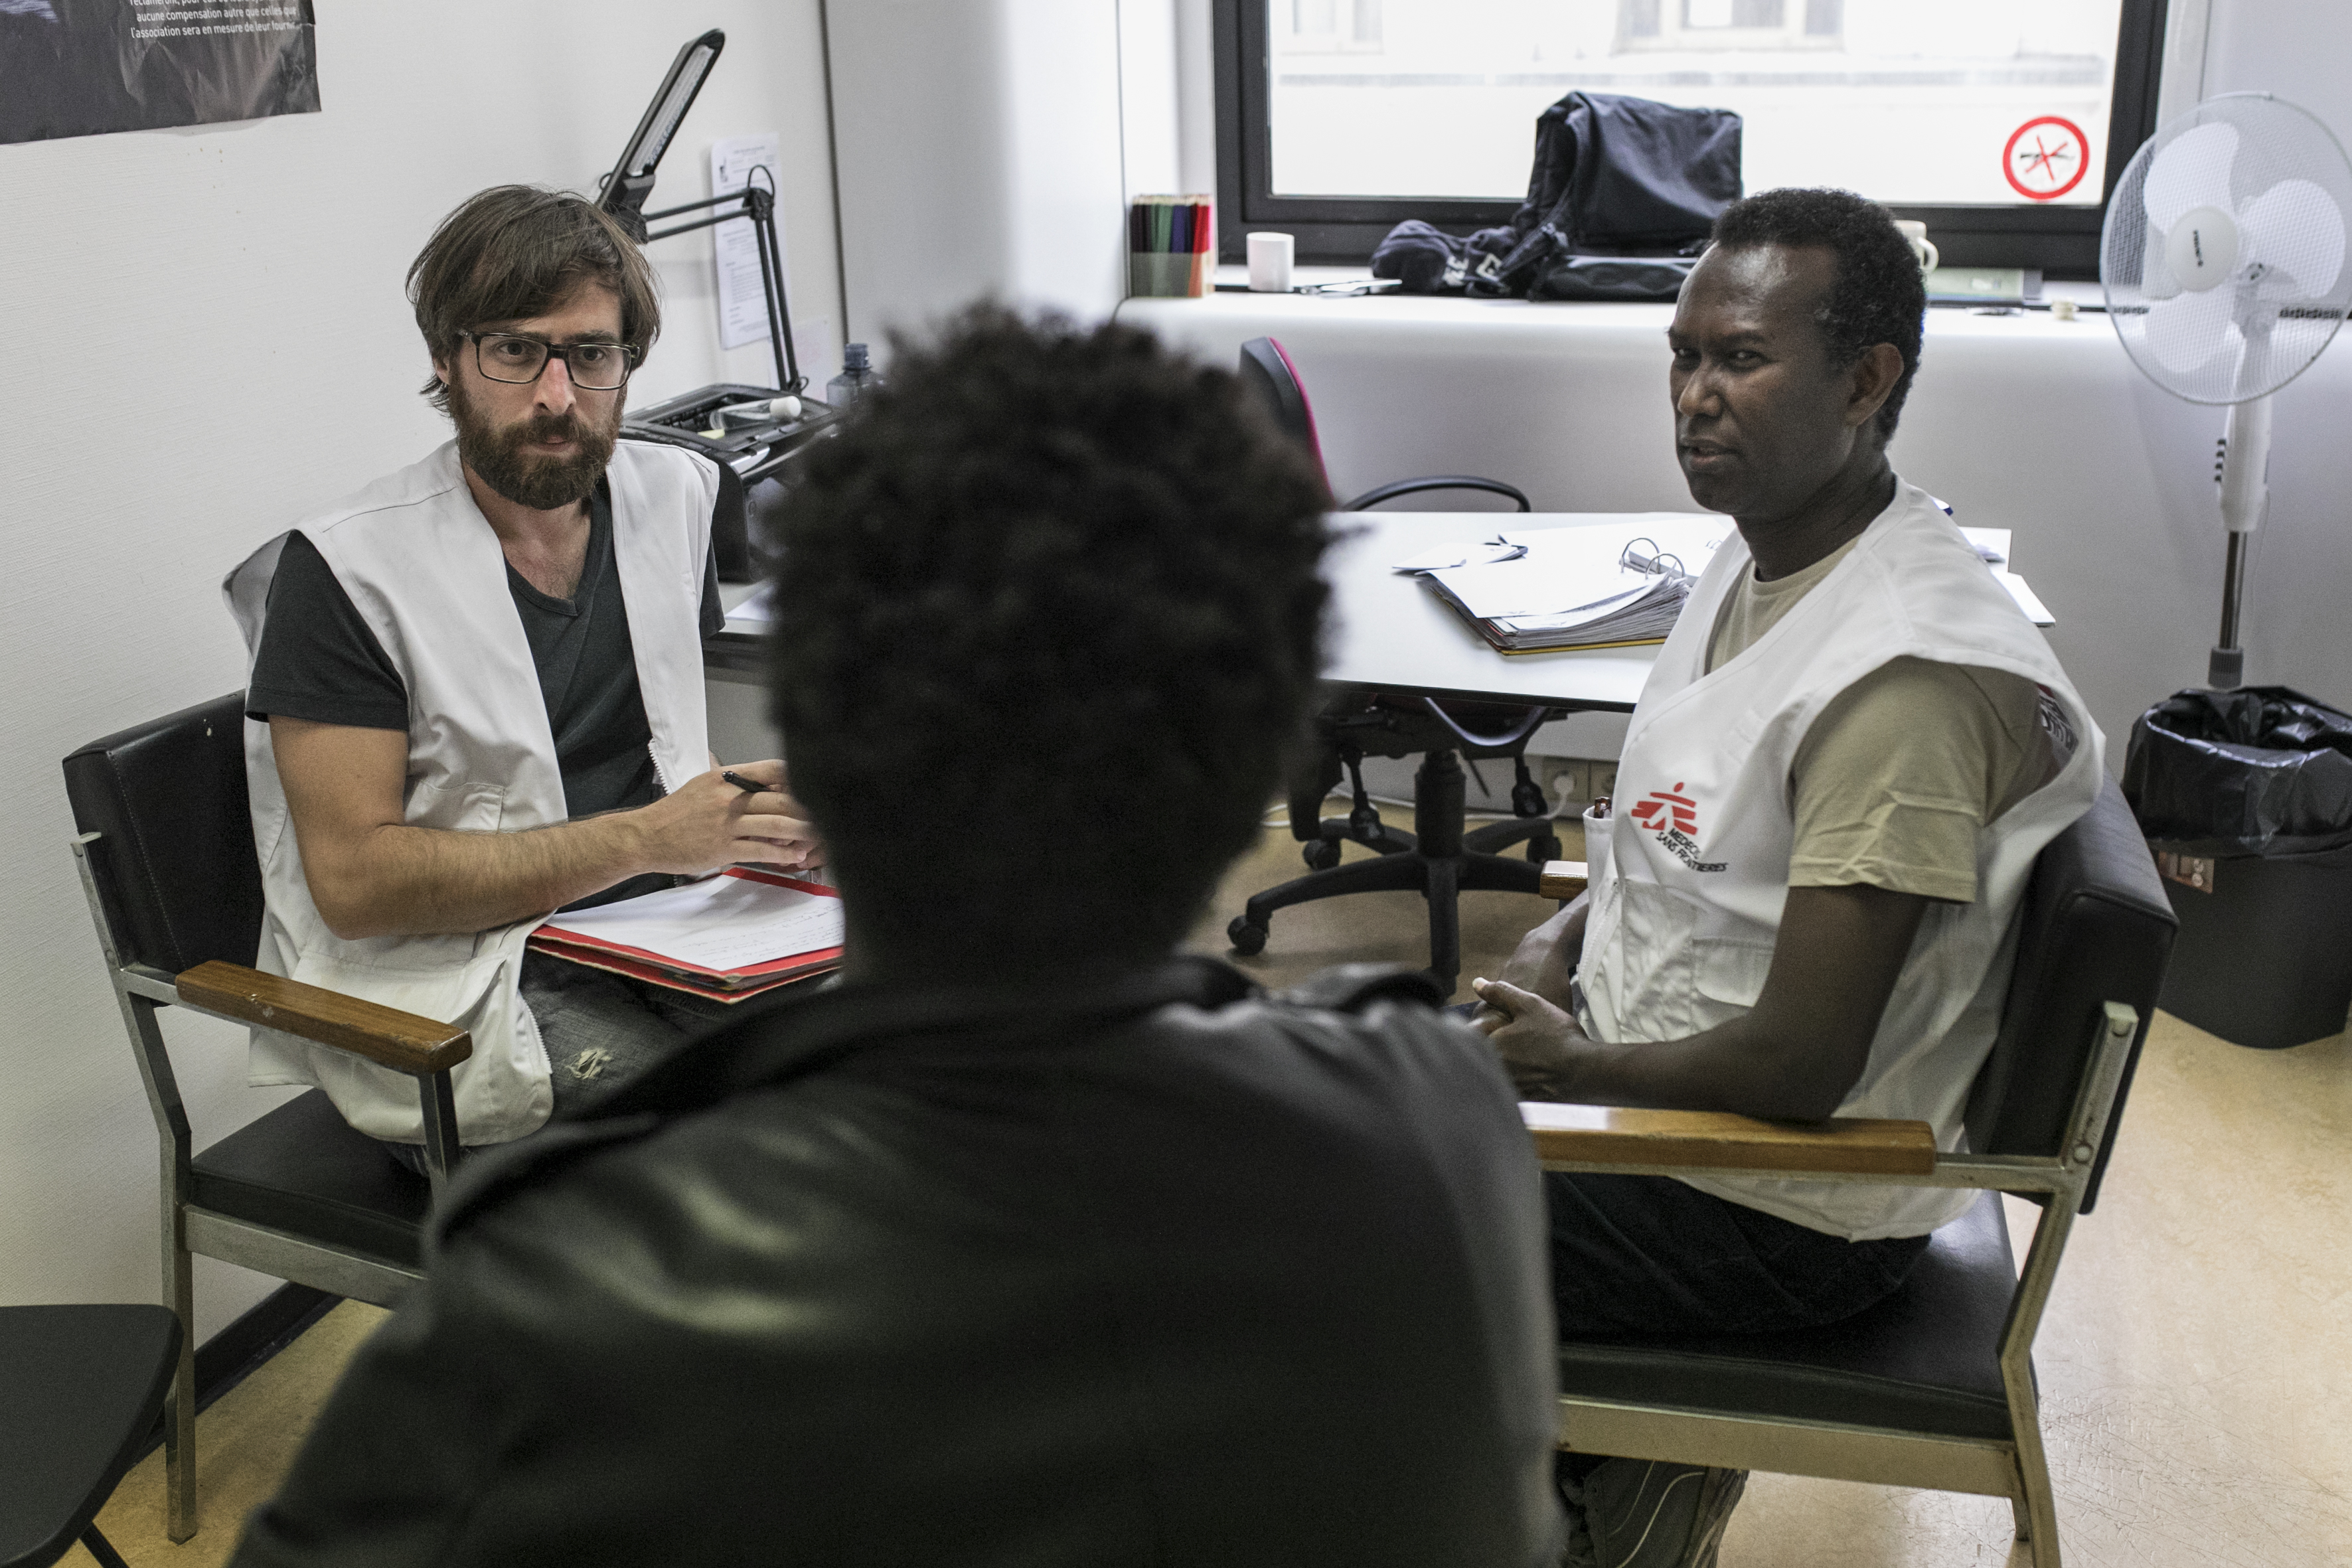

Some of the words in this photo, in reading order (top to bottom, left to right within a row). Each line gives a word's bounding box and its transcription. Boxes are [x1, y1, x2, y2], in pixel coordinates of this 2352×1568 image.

[137, 13, 165, 22] aucune
[166, 7, 222, 23] compensation
[224, 8, 244, 18] autre
[246, 8, 260, 19] que
[260, 5, 283, 17] celles
[283, 7, 297, 17] que
[131, 25, 181, 39] l'association
[182, 27, 201, 36] sera
[202, 26, 212, 35] en
[213, 24, 244, 35] mesure
[244, 22, 255, 33] de
[255, 21, 270, 32] leur
[1656, 832, 1679, 852] SANS
[1668, 828, 1701, 859] MEDECI
